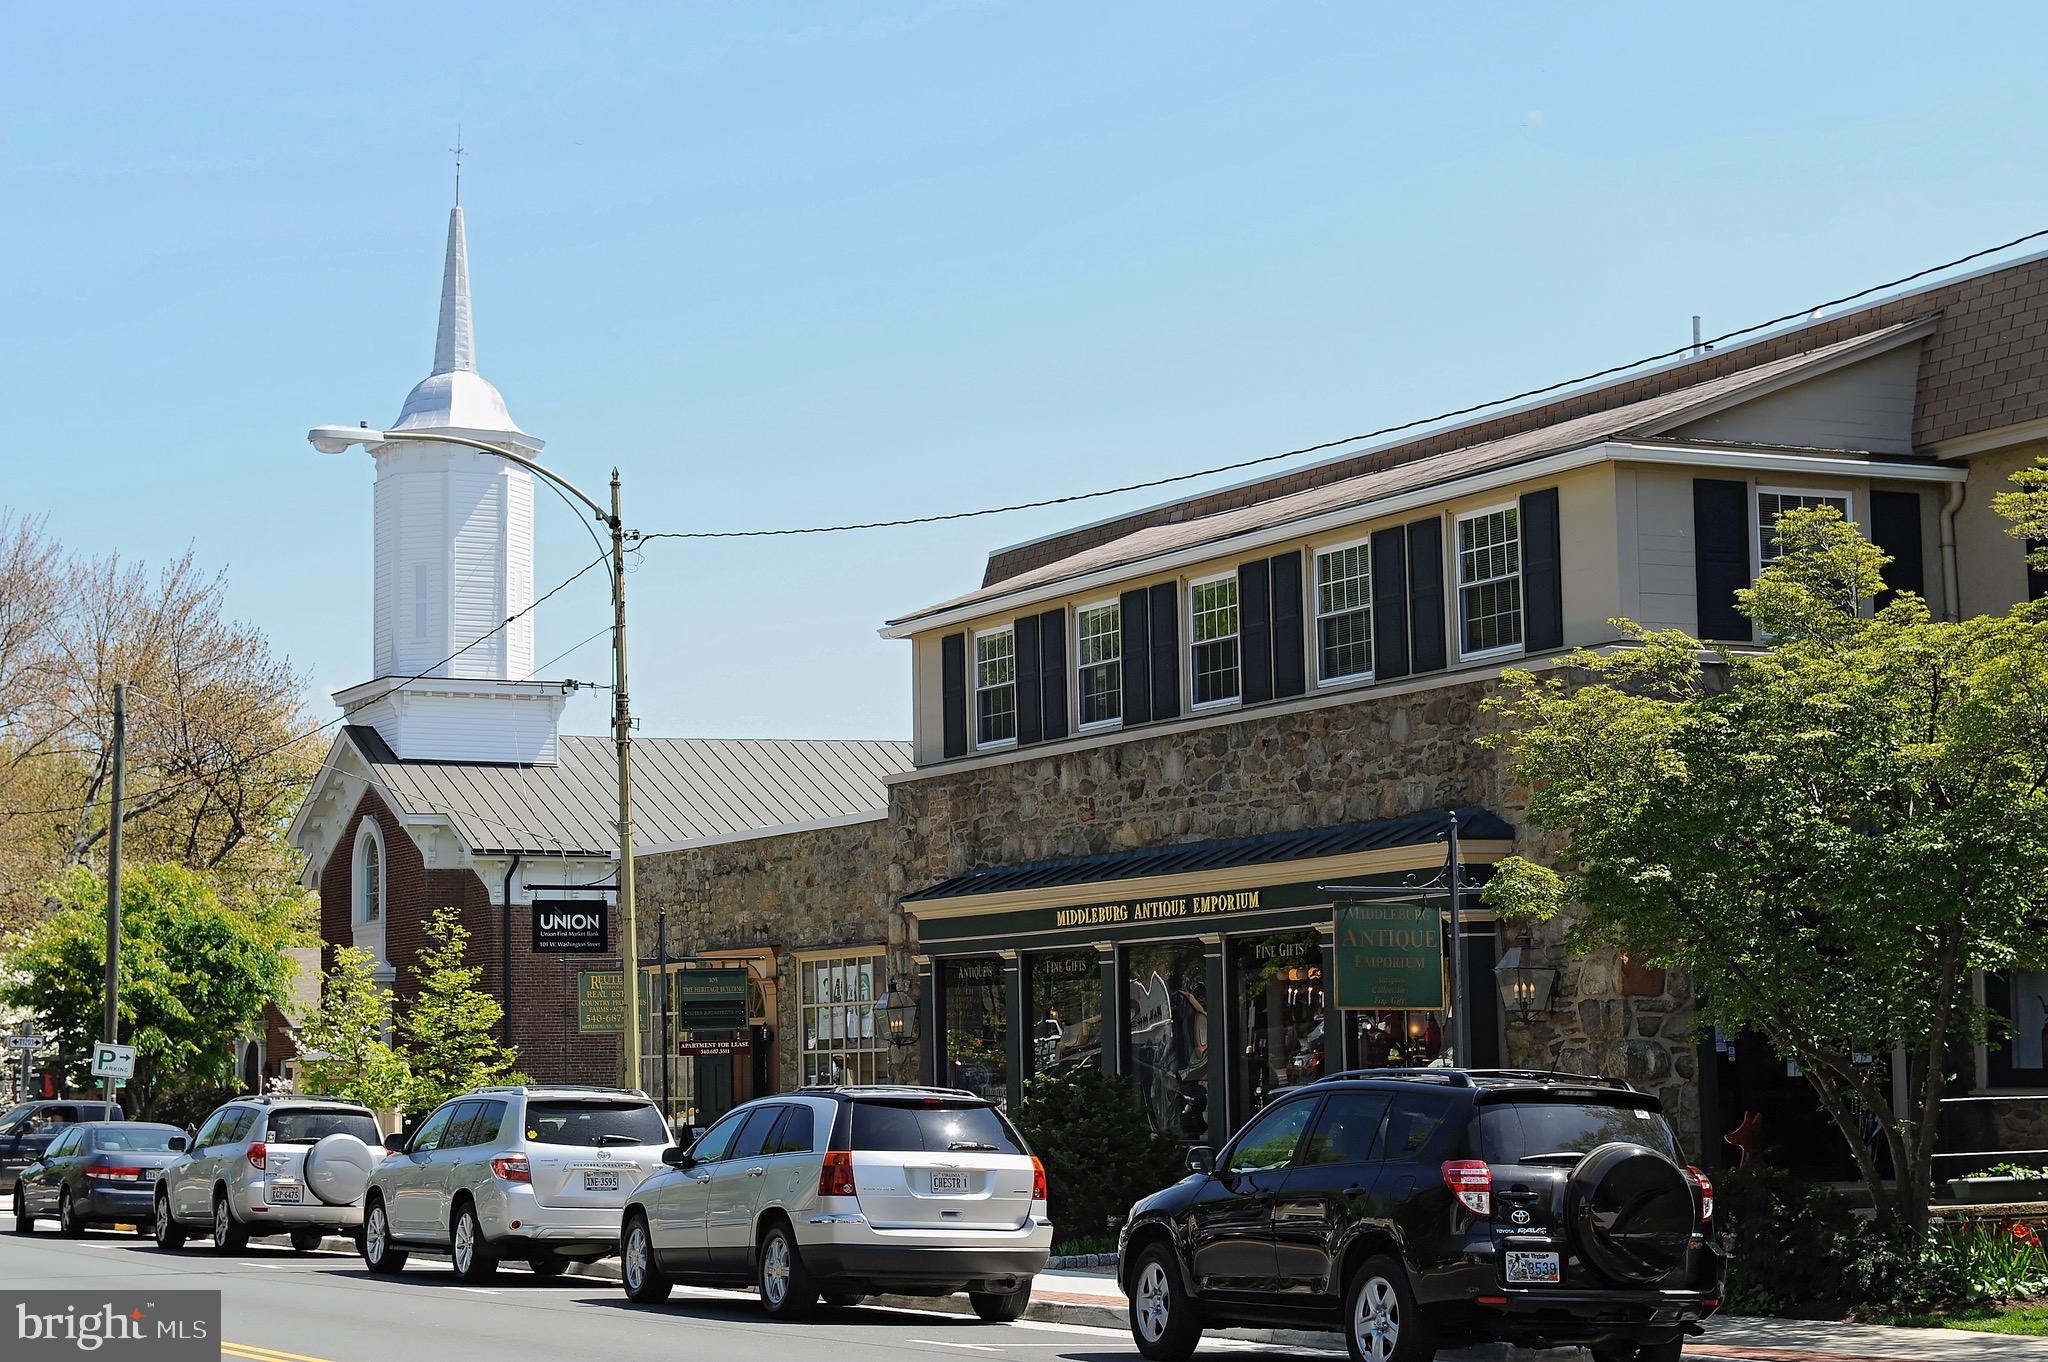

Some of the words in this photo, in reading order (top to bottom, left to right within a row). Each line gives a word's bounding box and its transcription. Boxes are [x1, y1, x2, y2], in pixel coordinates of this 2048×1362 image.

[1057, 904, 1129, 927] MIDDLEBURG
[1134, 899, 1187, 920] ANTIQUE
[1193, 891, 1260, 914] EMPORIUM
[1348, 908, 1431, 920] MIDDLEBURG
[540, 913, 600, 930] UNION
[1342, 928, 1438, 951] ANTIQUE
[1256, 944, 1277, 959] FINE
[1279, 943, 1305, 957] GIFTS
[1046, 961, 1064, 974] FINE
[1065, 959, 1087, 972] GIFTS
[1355, 955, 1425, 969] EMPORIUM
[933, 1177, 961, 1188] CHESTR
